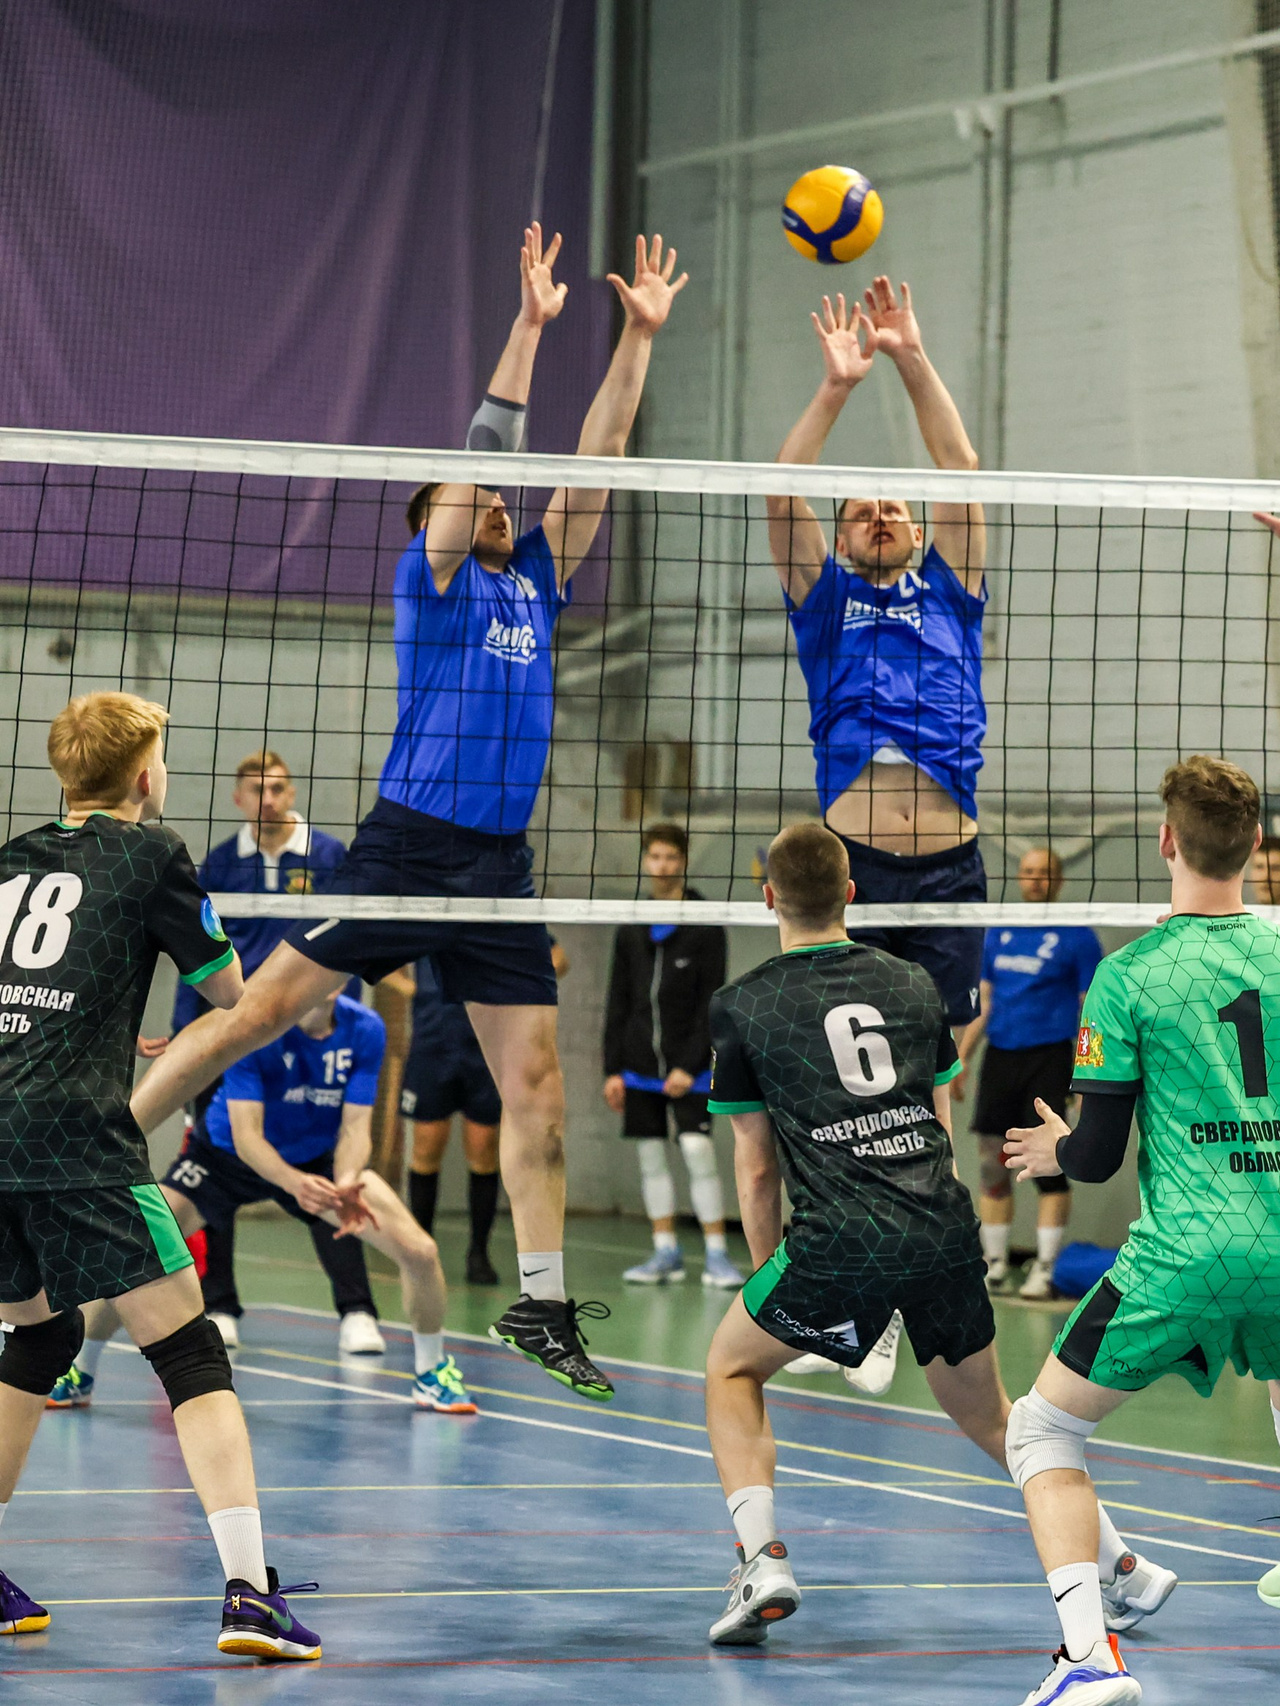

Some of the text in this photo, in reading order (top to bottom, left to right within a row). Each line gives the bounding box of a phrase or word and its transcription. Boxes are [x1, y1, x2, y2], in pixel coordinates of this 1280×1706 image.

[0, 872, 83, 969] 18
[1206, 922, 1246, 932] REBORN
[1037, 932, 1059, 959] 2
[0, 984, 75, 1012] ОВСКАЯ
[824, 1003, 897, 1096] 6
[1218, 989, 1268, 1098] 1
[322, 1048, 353, 1085] 15
[811, 1104, 936, 1143] СВЕРДЛОВСКА
[171, 1159, 210, 1189] 15
